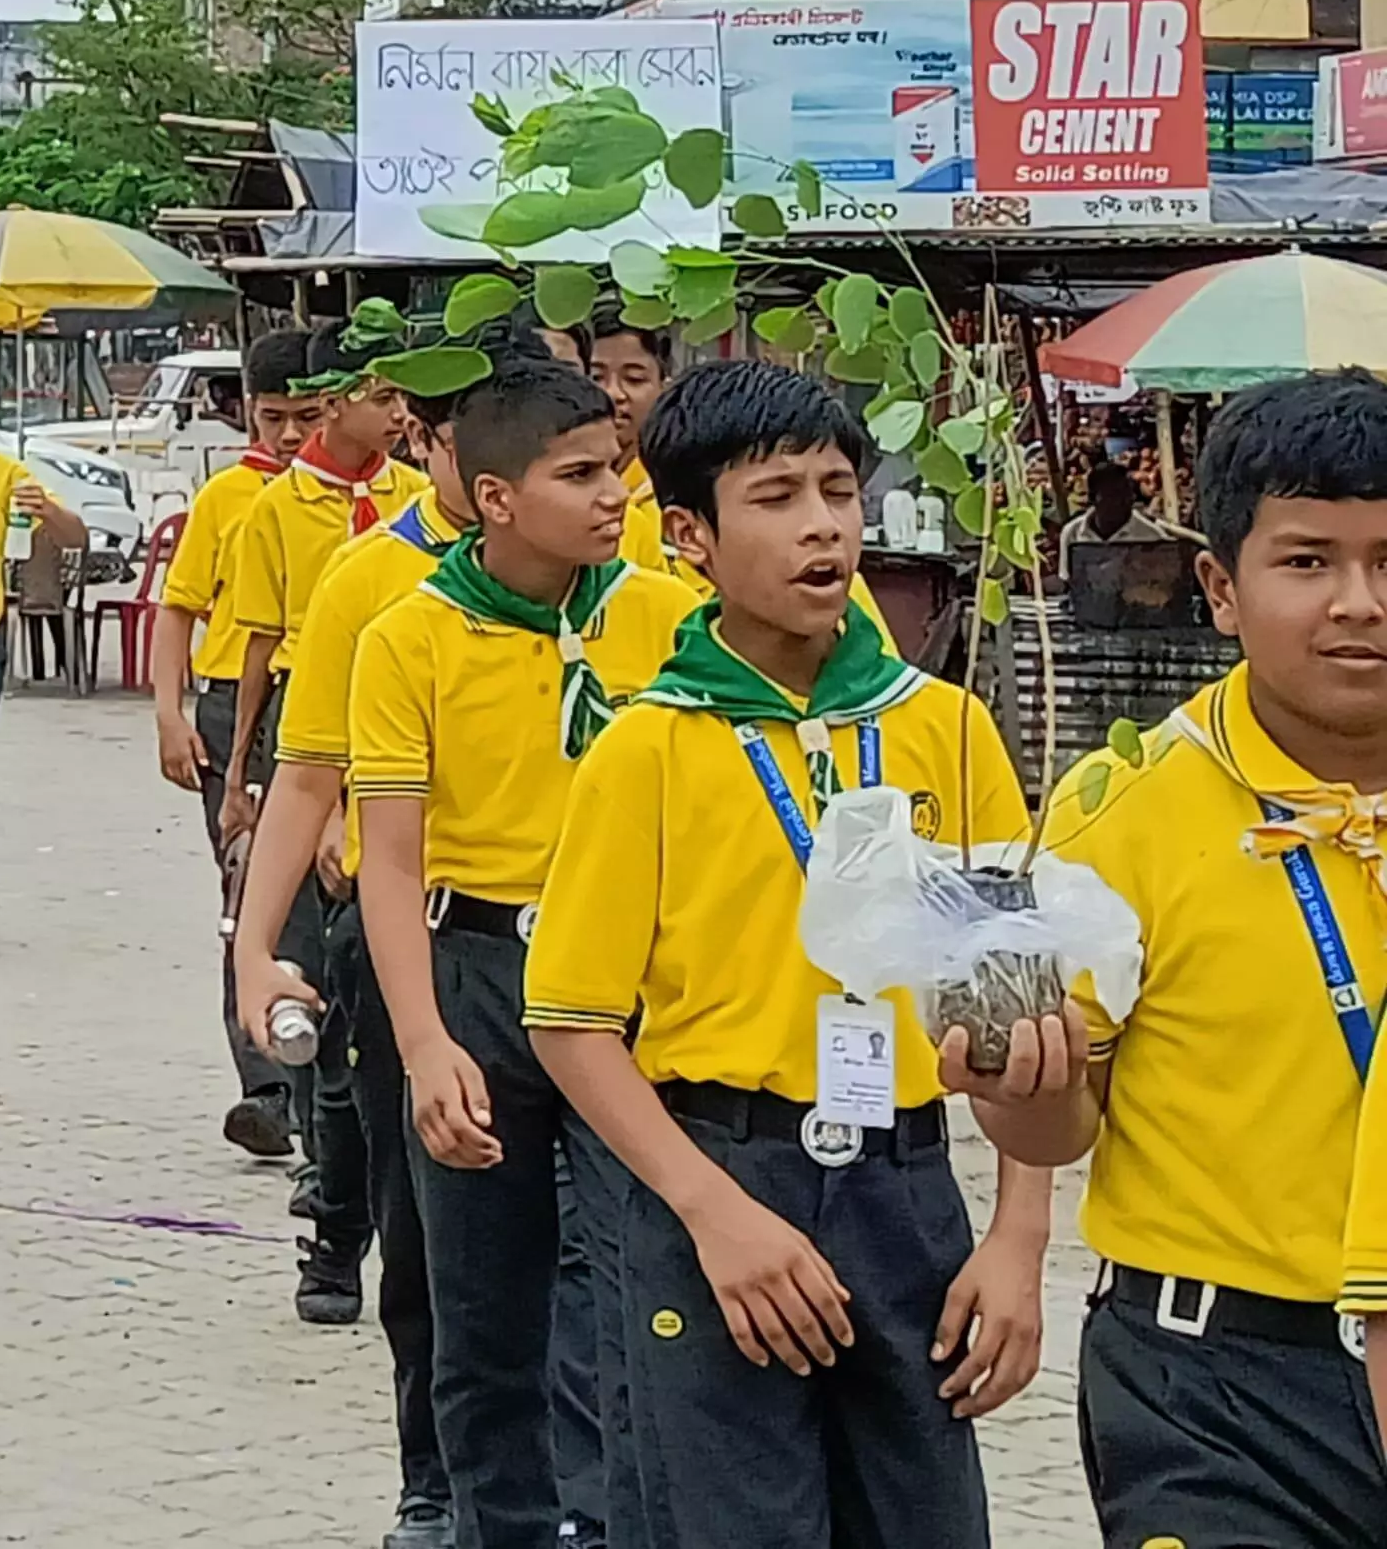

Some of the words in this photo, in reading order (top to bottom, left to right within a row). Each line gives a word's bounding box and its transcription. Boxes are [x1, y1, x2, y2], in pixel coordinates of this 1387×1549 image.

[987, 0, 1189, 103] STAR
[1264, 91, 1298, 104] DSP
[1018, 107, 1162, 156] CEMENT
[1015, 164, 1075, 183] Solid
[1082, 162, 1170, 184] Setting
[826, 203, 898, 221] FOOD
